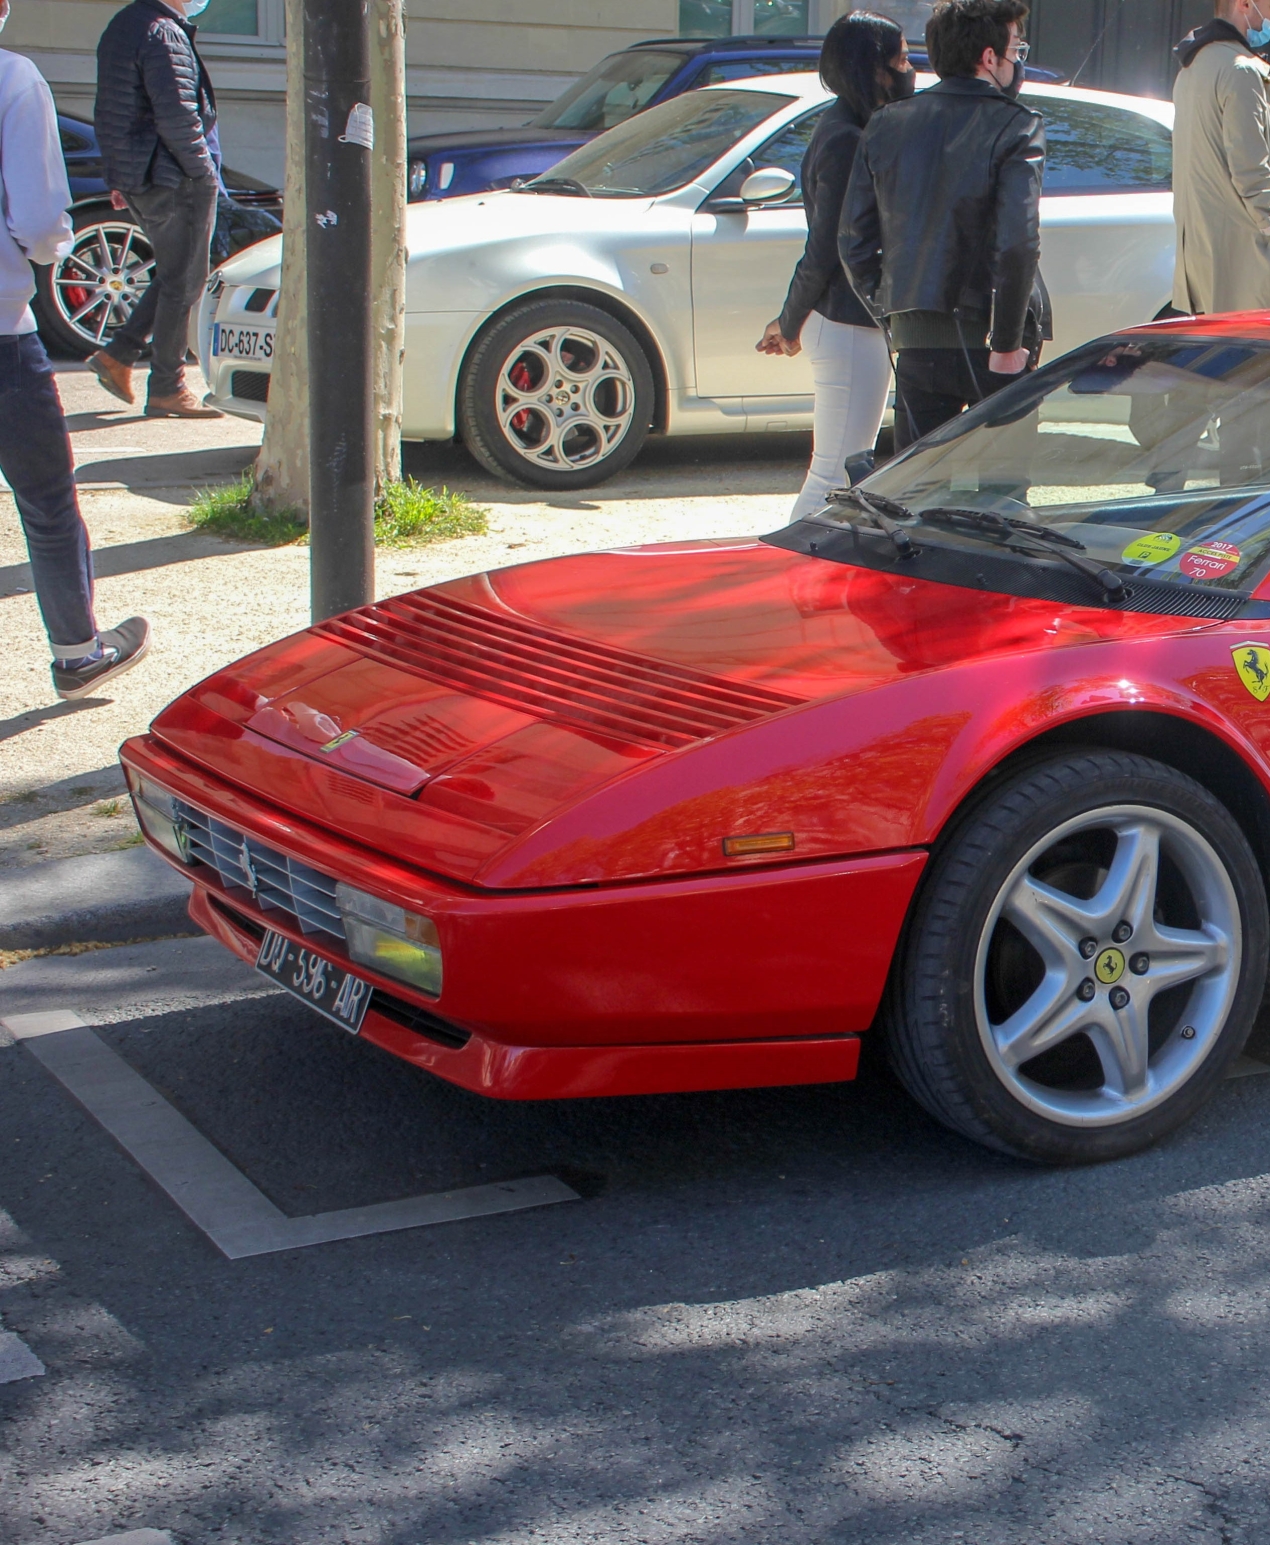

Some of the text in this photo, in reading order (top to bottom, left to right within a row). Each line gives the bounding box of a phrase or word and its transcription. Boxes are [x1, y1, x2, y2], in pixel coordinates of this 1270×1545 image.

[220, 328, 276, 358] DC-637-S
[1211, 541, 1233, 550] 2017
[1187, 555, 1227, 570] Ferrari
[1189, 567, 1206, 577] 70
